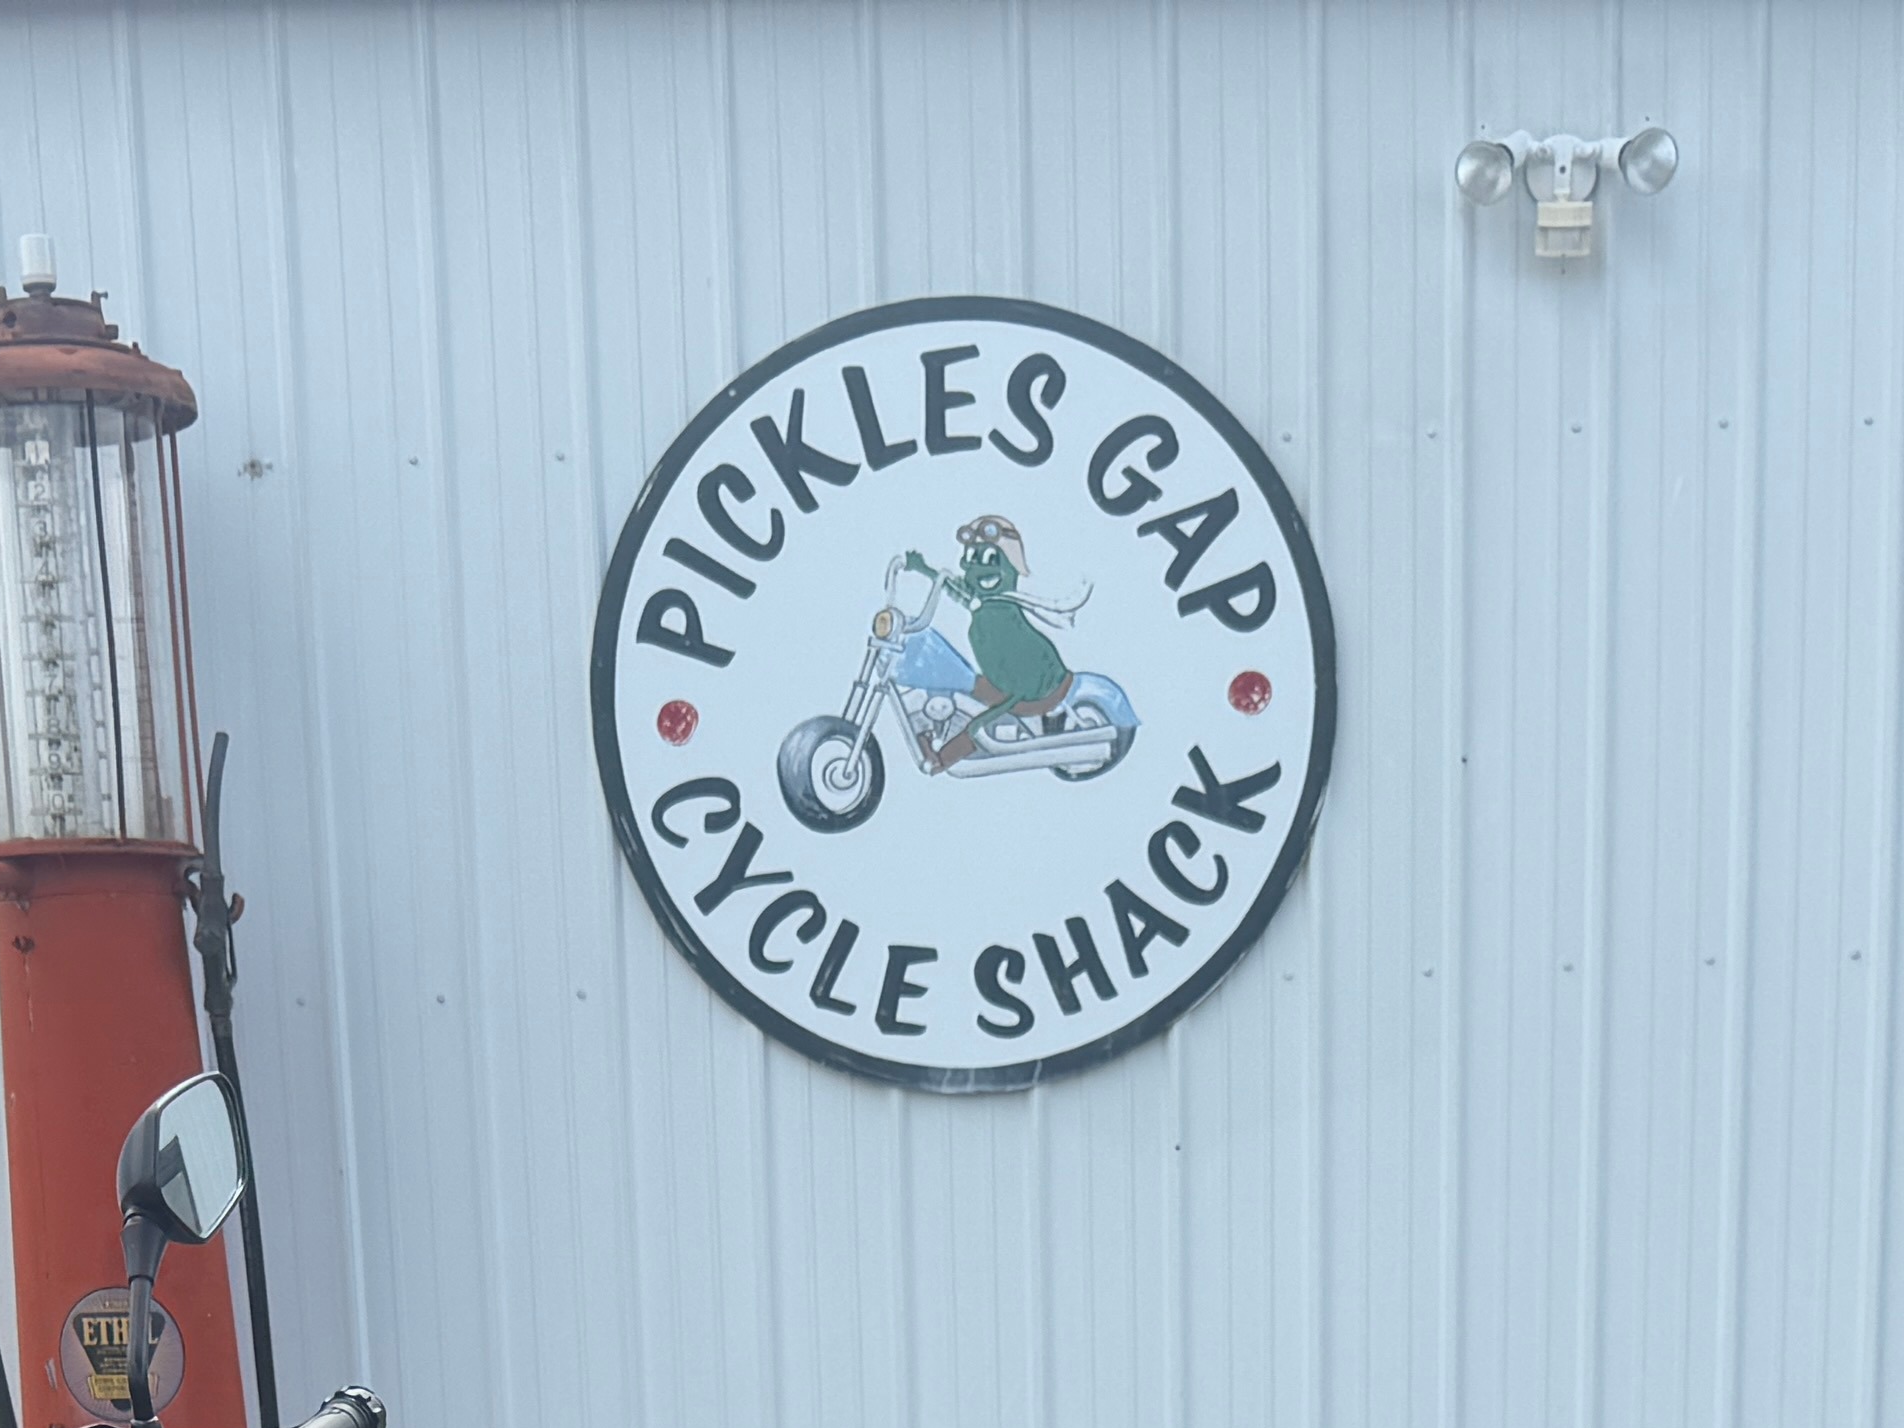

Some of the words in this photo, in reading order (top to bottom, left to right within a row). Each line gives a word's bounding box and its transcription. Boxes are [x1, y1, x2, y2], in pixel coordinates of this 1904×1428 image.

[636, 344, 1067, 668] PICKLES
[1086, 414, 1276, 633] GAP
[651, 776, 938, 1036] CYCLE
[972, 744, 1282, 1039] SHACK
[81, 1316, 159, 1346] ETHL
